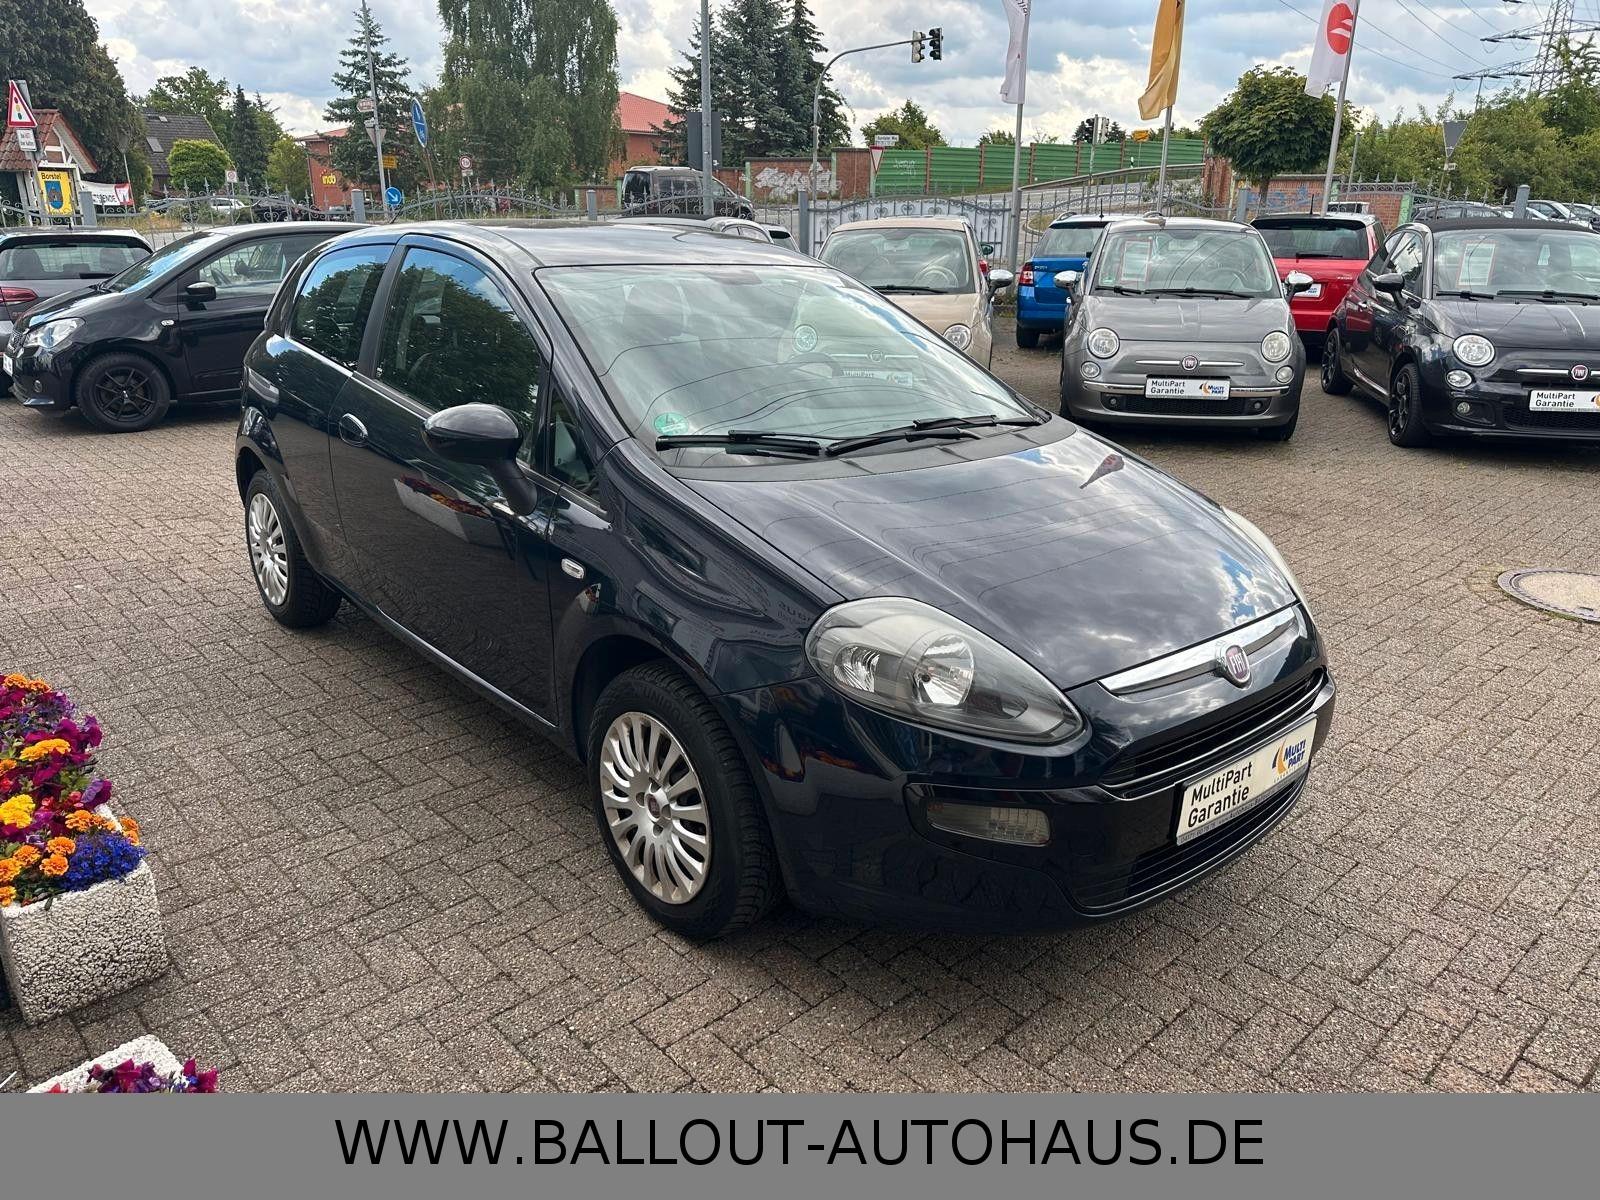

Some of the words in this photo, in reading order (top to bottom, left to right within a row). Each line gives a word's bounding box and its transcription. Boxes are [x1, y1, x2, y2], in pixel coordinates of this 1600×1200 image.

[41, 172, 62, 180] Borstel
[1150, 387, 1185, 395] Garantie
[1536, 392, 1576, 400] MultiPart
[1535, 399, 1575, 408] Garantie
[1229, 652, 1247, 675] FIAT
[1283, 739, 1307, 762] MULTI
[1287, 749, 1306, 769] PART
[1190, 761, 1252, 807] MultiPart
[1187, 785, 1250, 828] Garantie
